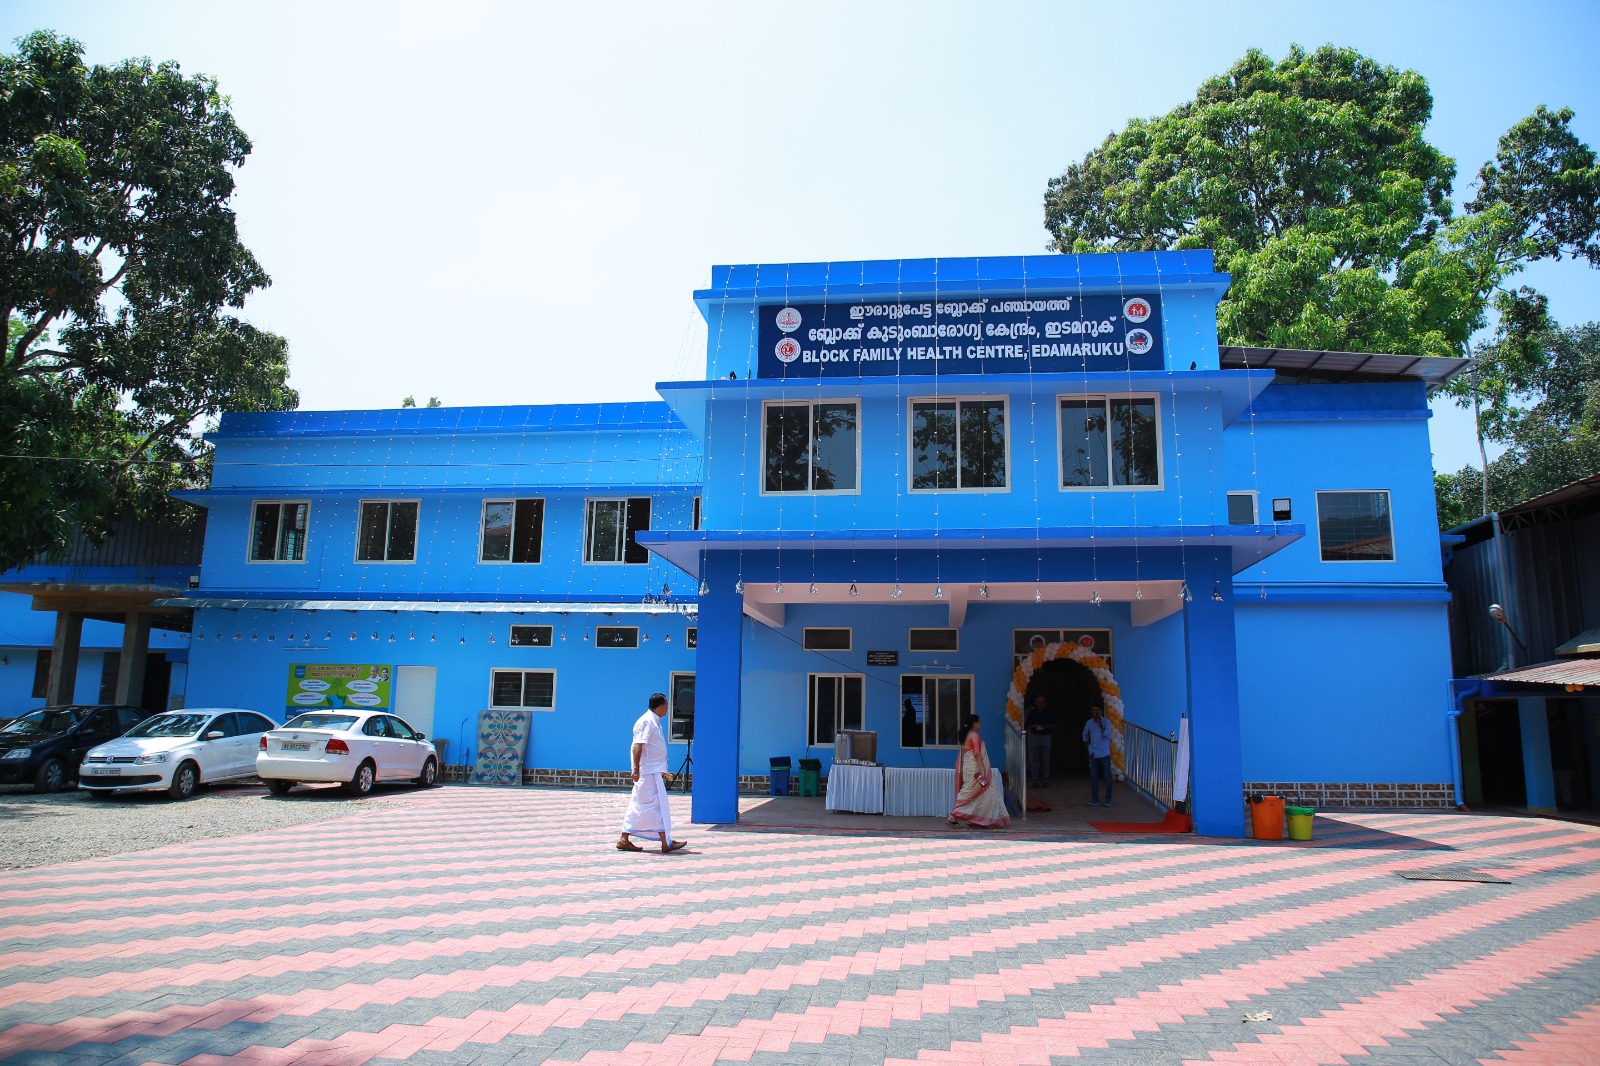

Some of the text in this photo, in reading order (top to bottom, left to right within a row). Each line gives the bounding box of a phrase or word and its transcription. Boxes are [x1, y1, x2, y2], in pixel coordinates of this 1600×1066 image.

[850, 296, 1072, 320] ഈരാറ്റുപേട്ട ബ്ലോക്ക് പഞ്ചായത്ത്
[808, 323, 865, 345] ബ്ലോക്ക്
[867, 322, 982, 343] കുടുംബാരോഗ്യ
[1044, 316, 1117, 338] ഇടമറുക്
[802, 348, 849, 363] BLOCK
[853, 347, 903, 362] FAMILY
[907, 345, 962, 360] HEALTH
[966, 344, 1028, 360] CENTRE,
[1031, 342, 1124, 358] EDAMARUKU
